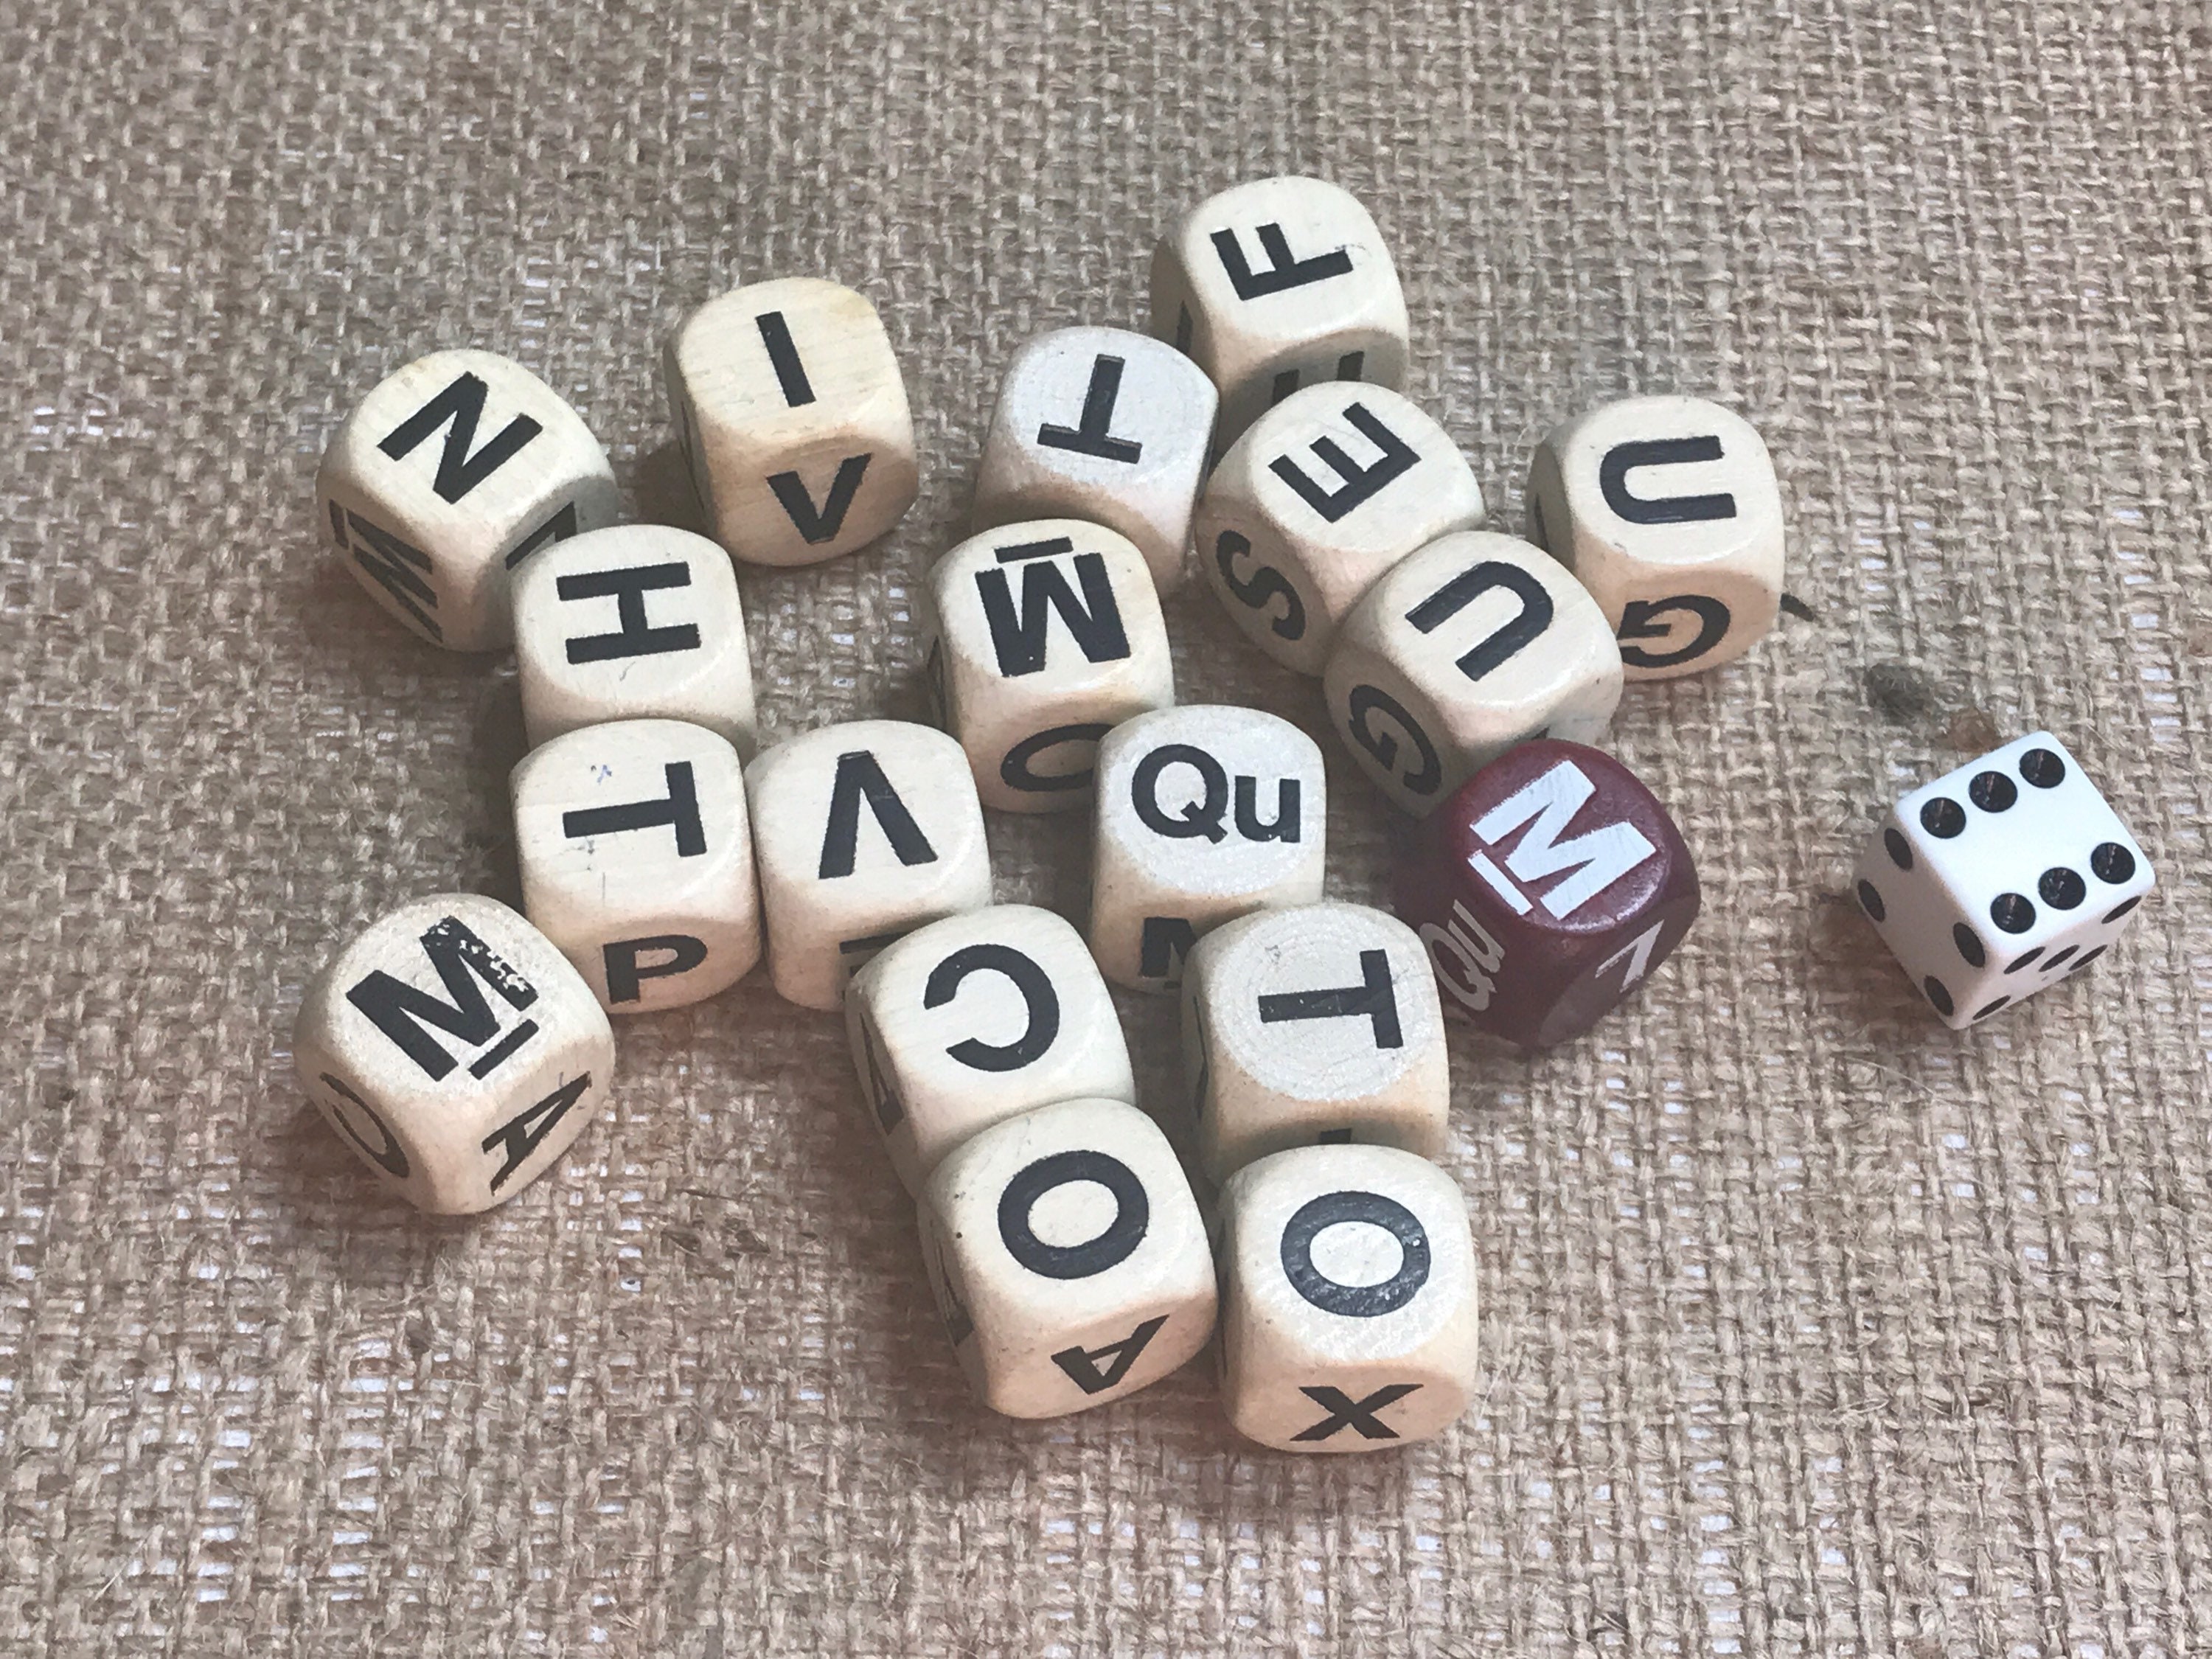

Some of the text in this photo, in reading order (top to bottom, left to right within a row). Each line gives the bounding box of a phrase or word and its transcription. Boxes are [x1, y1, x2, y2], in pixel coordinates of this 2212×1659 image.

[1210, 223, 1353, 301] F
[756, 311, 816, 408] I
[1037, 354, 1143, 465] T
[377, 371, 543, 504] N
[1267, 402, 1422, 523] E
[1599, 435, 1736, 524] U
[767, 452, 872, 544] V
[556, 561, 701, 665] H
[1215, 529, 1306, 641] S
[1405, 560, 1554, 682] U
[1618, 594, 1731, 668] G
[1131, 743, 1301, 844] Qu
[1349, 684, 1442, 796] G
[562, 761, 707, 858] T
[819, 750, 938, 879] V
[603, 934, 708, 1004] P
[924, 942, 1060, 1073] C
[1258, 948, 1404, 1049] T
[1419, 899, 1506, 1012] Qu
[481, 1071, 592, 1197] A
[997, 1150, 1150, 1281] O
[1280, 1191, 1432, 1318] O
[1051, 1315, 1170, 1394] A
[1289, 1383, 1425, 1442] X
